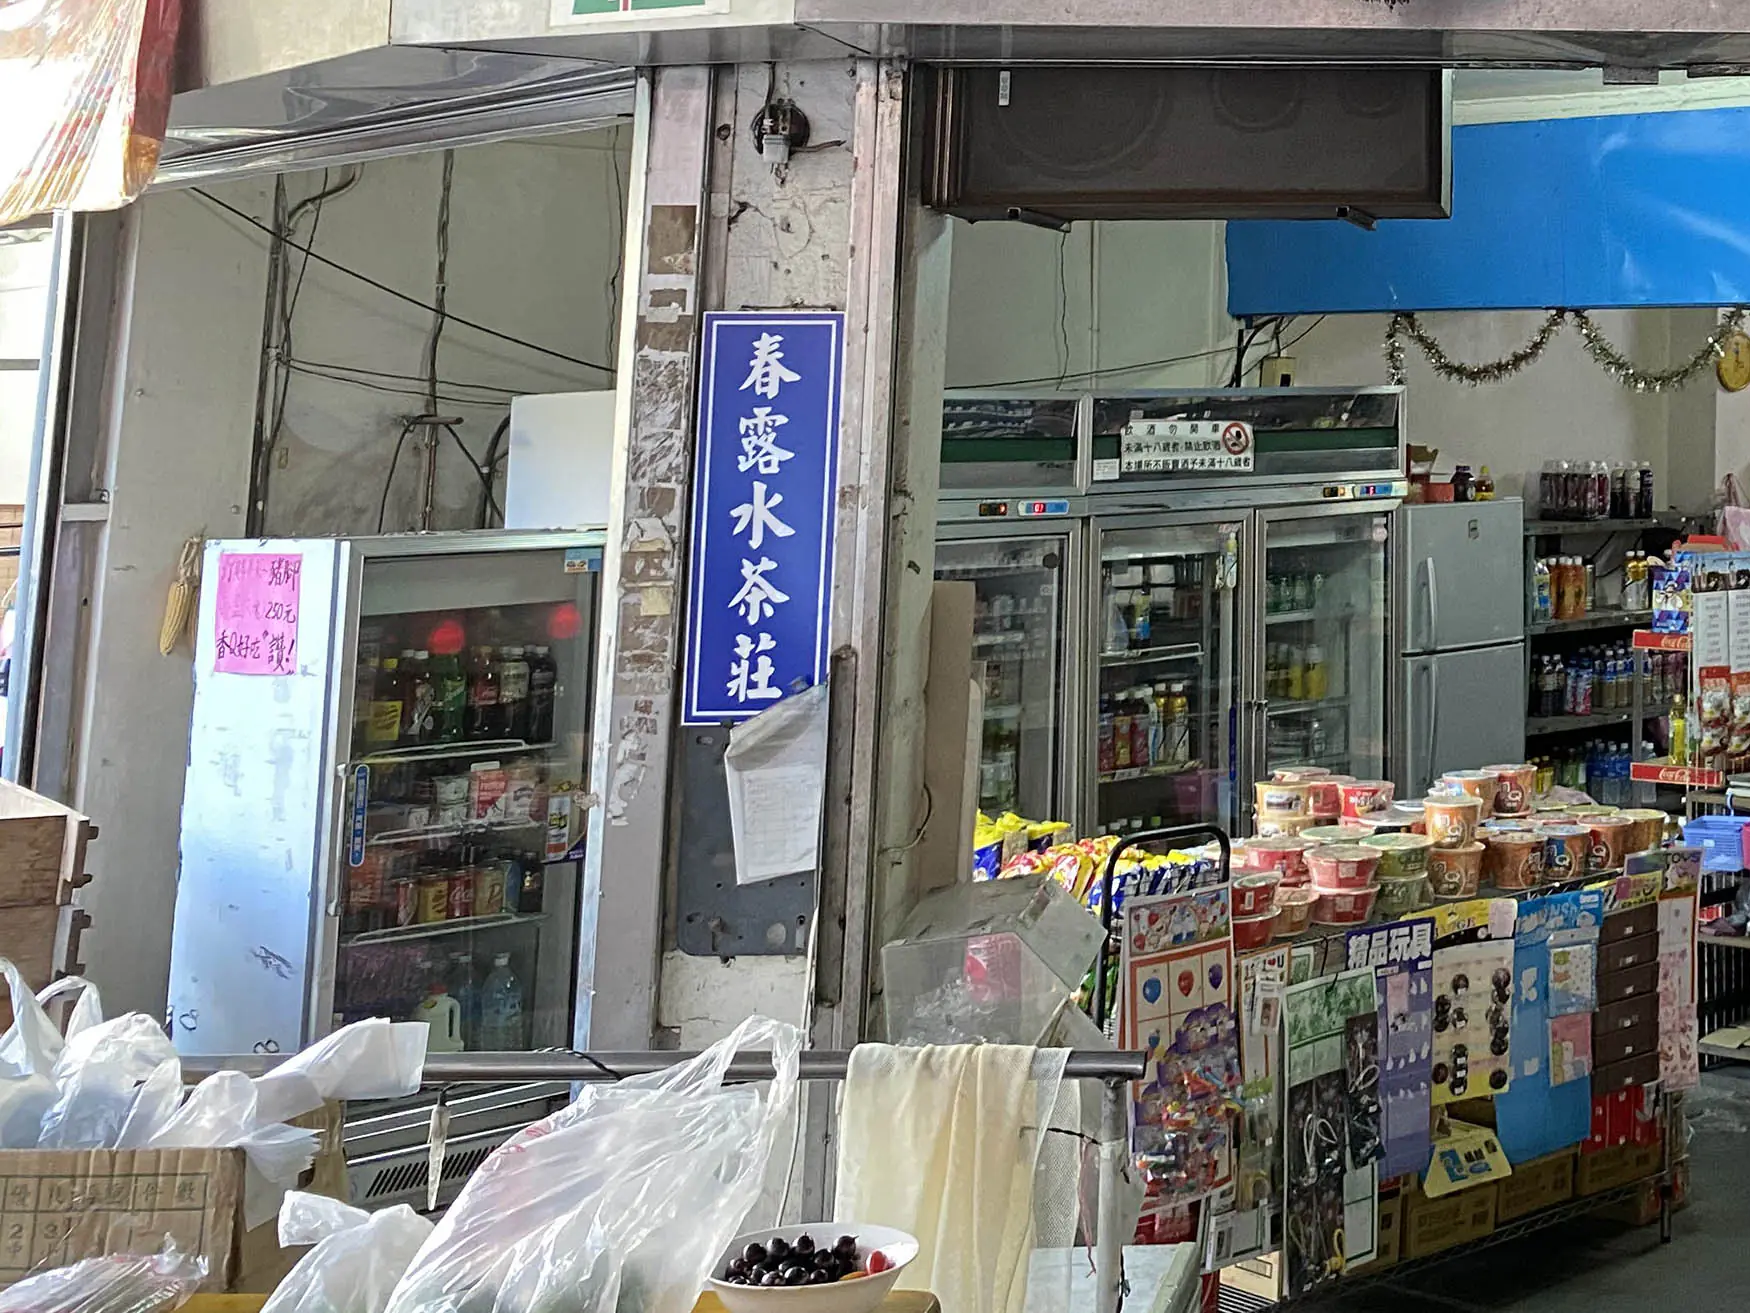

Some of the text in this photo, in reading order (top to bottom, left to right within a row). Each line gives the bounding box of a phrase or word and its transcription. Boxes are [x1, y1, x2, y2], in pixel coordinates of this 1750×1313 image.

[726, 331, 802, 704] 春露水茶莊
[1348, 922, 1432, 969] 精品玩具
